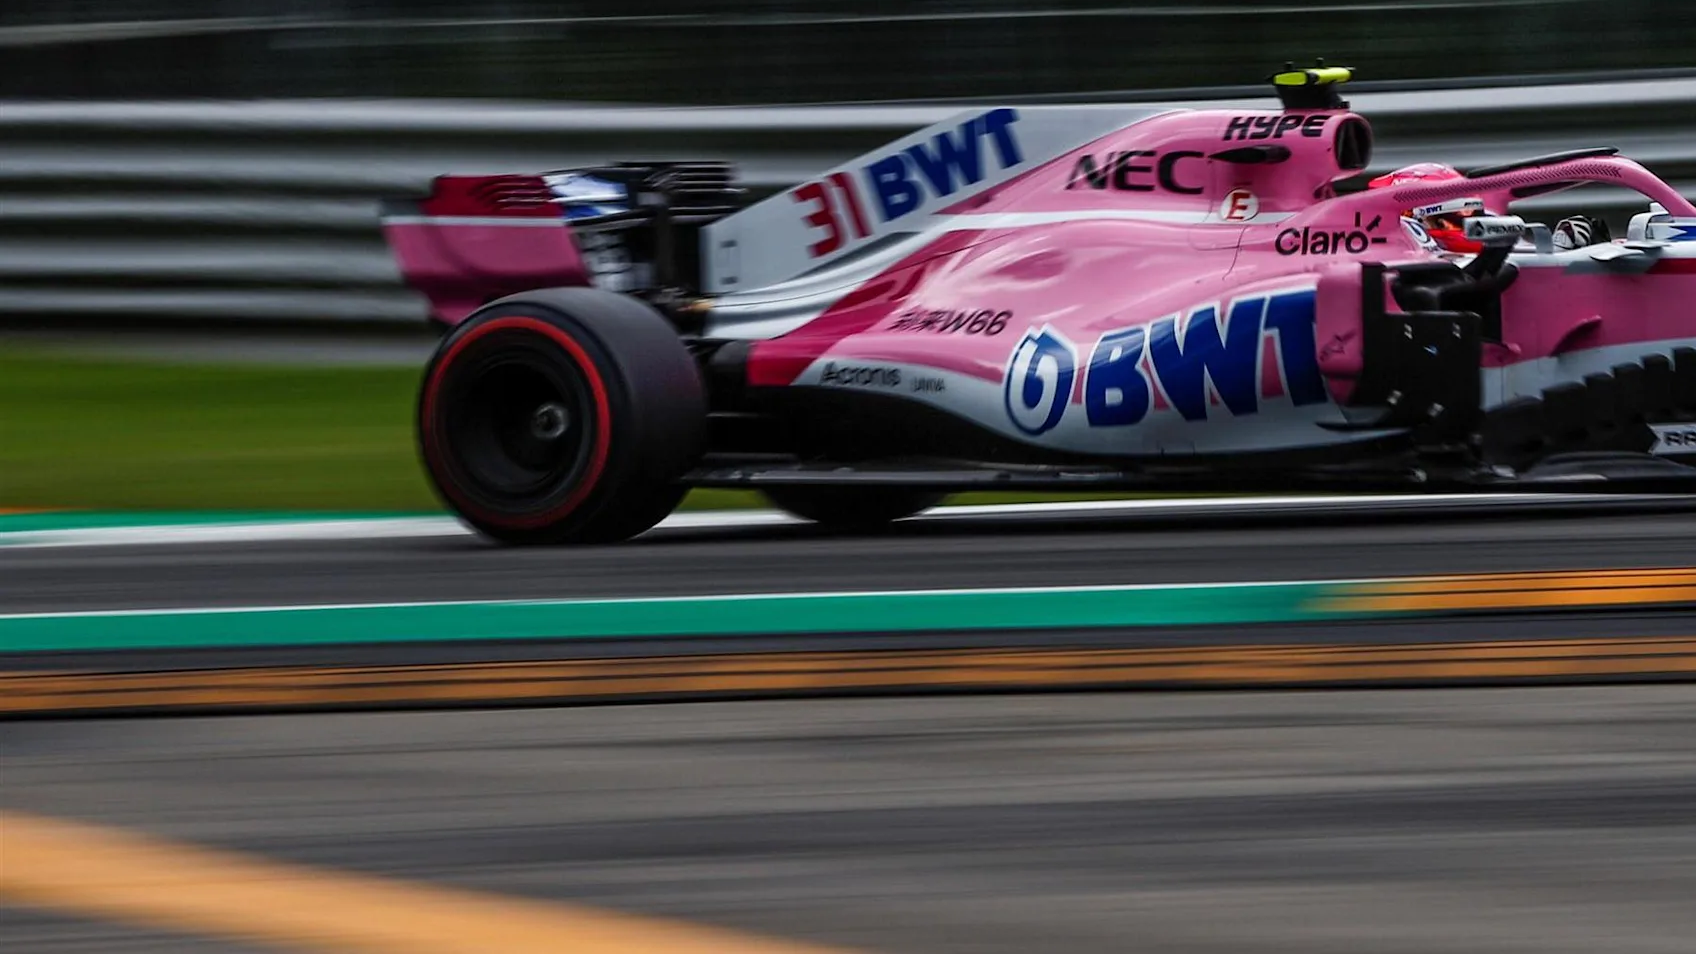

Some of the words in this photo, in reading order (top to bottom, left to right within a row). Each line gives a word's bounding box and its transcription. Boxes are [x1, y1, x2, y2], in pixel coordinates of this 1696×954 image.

[1222, 115, 1332, 141] HYPE
[791, 172, 872, 258] 31
[864, 108, 1023, 223] BWT
[1065, 150, 1205, 195] NEC
[1226, 192, 1251, 220] E
[1275, 226, 1369, 256] Claro
[1086, 288, 1329, 428] BWT
